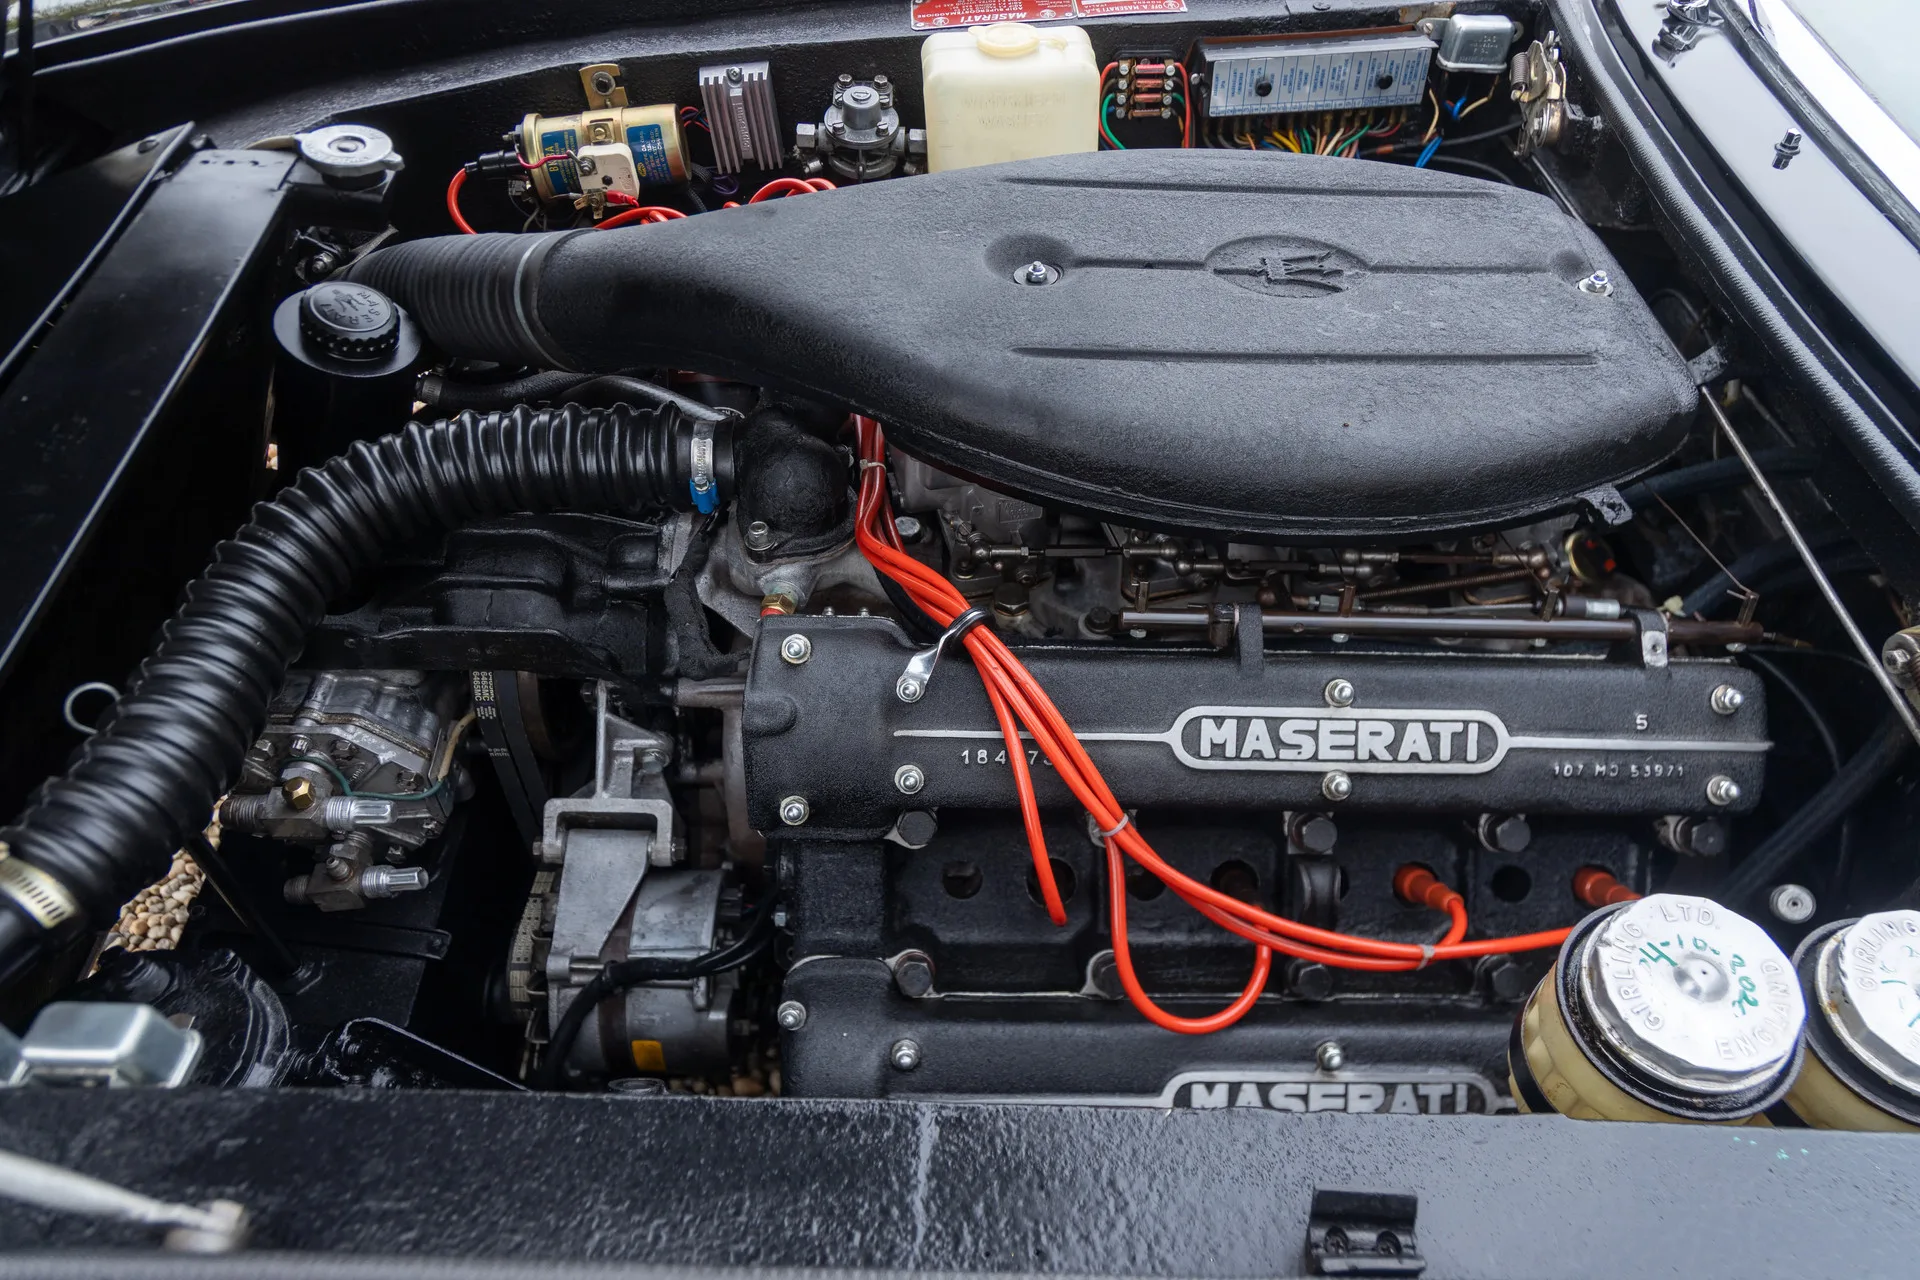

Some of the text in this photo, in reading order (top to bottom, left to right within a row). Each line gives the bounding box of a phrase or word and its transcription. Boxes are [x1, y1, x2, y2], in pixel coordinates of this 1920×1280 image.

[960, 12, 1028, 23] MASERATI
[320, 291, 380, 325] MASERATI
[1199, 717, 1479, 763] MASERATI
[1635, 713, 1648, 730] 5
[1852, 919, 1920, 991] GIRLING
[1611, 920, 1664, 1031] GIRLING
[1715, 960, 1792, 1060] ENGLAND
[1190, 1082, 1468, 1114] MASERATI
